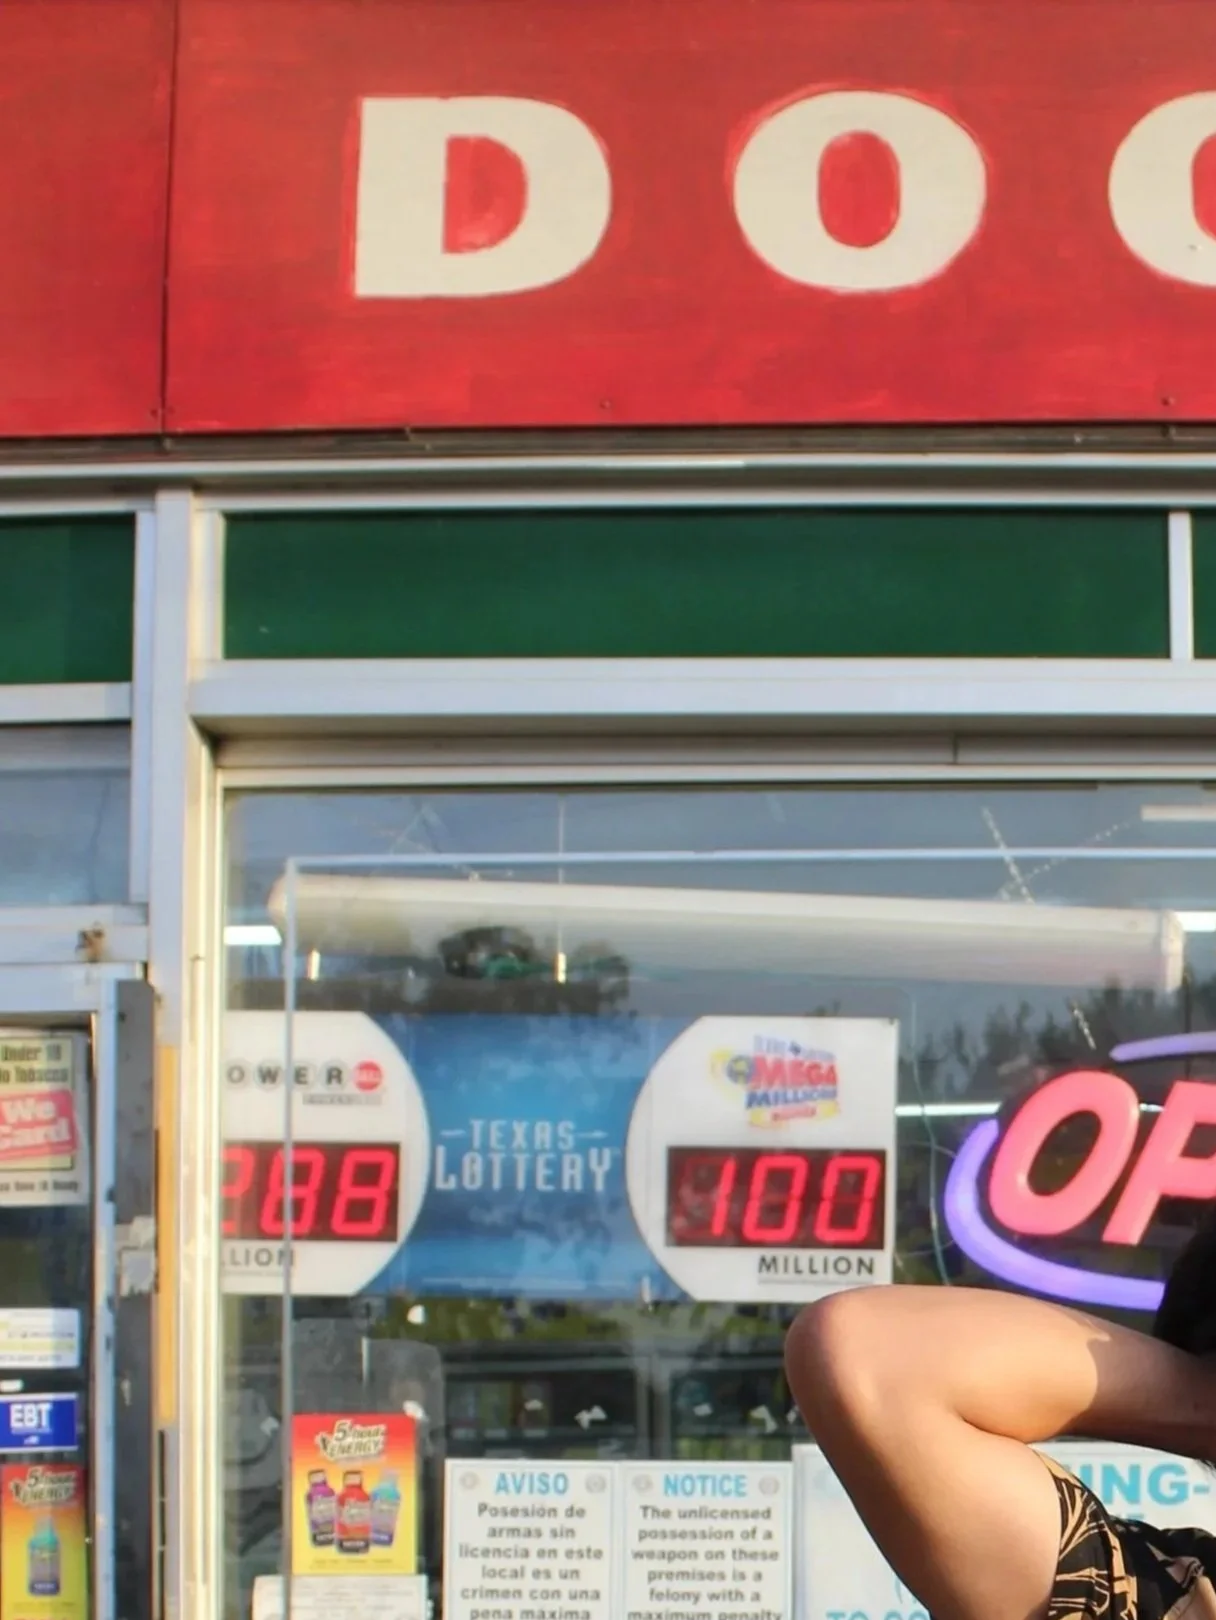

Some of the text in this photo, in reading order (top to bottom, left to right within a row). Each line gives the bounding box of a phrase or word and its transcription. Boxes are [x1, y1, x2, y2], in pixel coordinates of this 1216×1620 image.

[470, 1119, 576, 1149] TEXAS
[435, 1146, 612, 1191] LOTTERY
[711, 1156, 882, 1243] 100
[757, 1255, 875, 1276] MILLION
[10, 1403, 51, 1428] EBT
[494, 1472, 568, 1495] AVISO
[662, 1474, 746, 1497] NOTICE
[1065, 1463, 1211, 1506] ING-
[478, 1502, 586, 1518] Posesión de
[640, 1505, 772, 1520] The unlicensed
[487, 1524, 575, 1539] armas sin
[638, 1526, 773, 1543] possession of a
[459, 1544, 603, 1560] licencia en este
[631, 1546, 779, 1564] weapon on these
[482, 1565, 580, 1580] local es un
[647, 1567, 762, 1584] premises is a
[460, 1586, 601, 1600] crimen con una
[649, 1588, 760, 1605] felony with a
